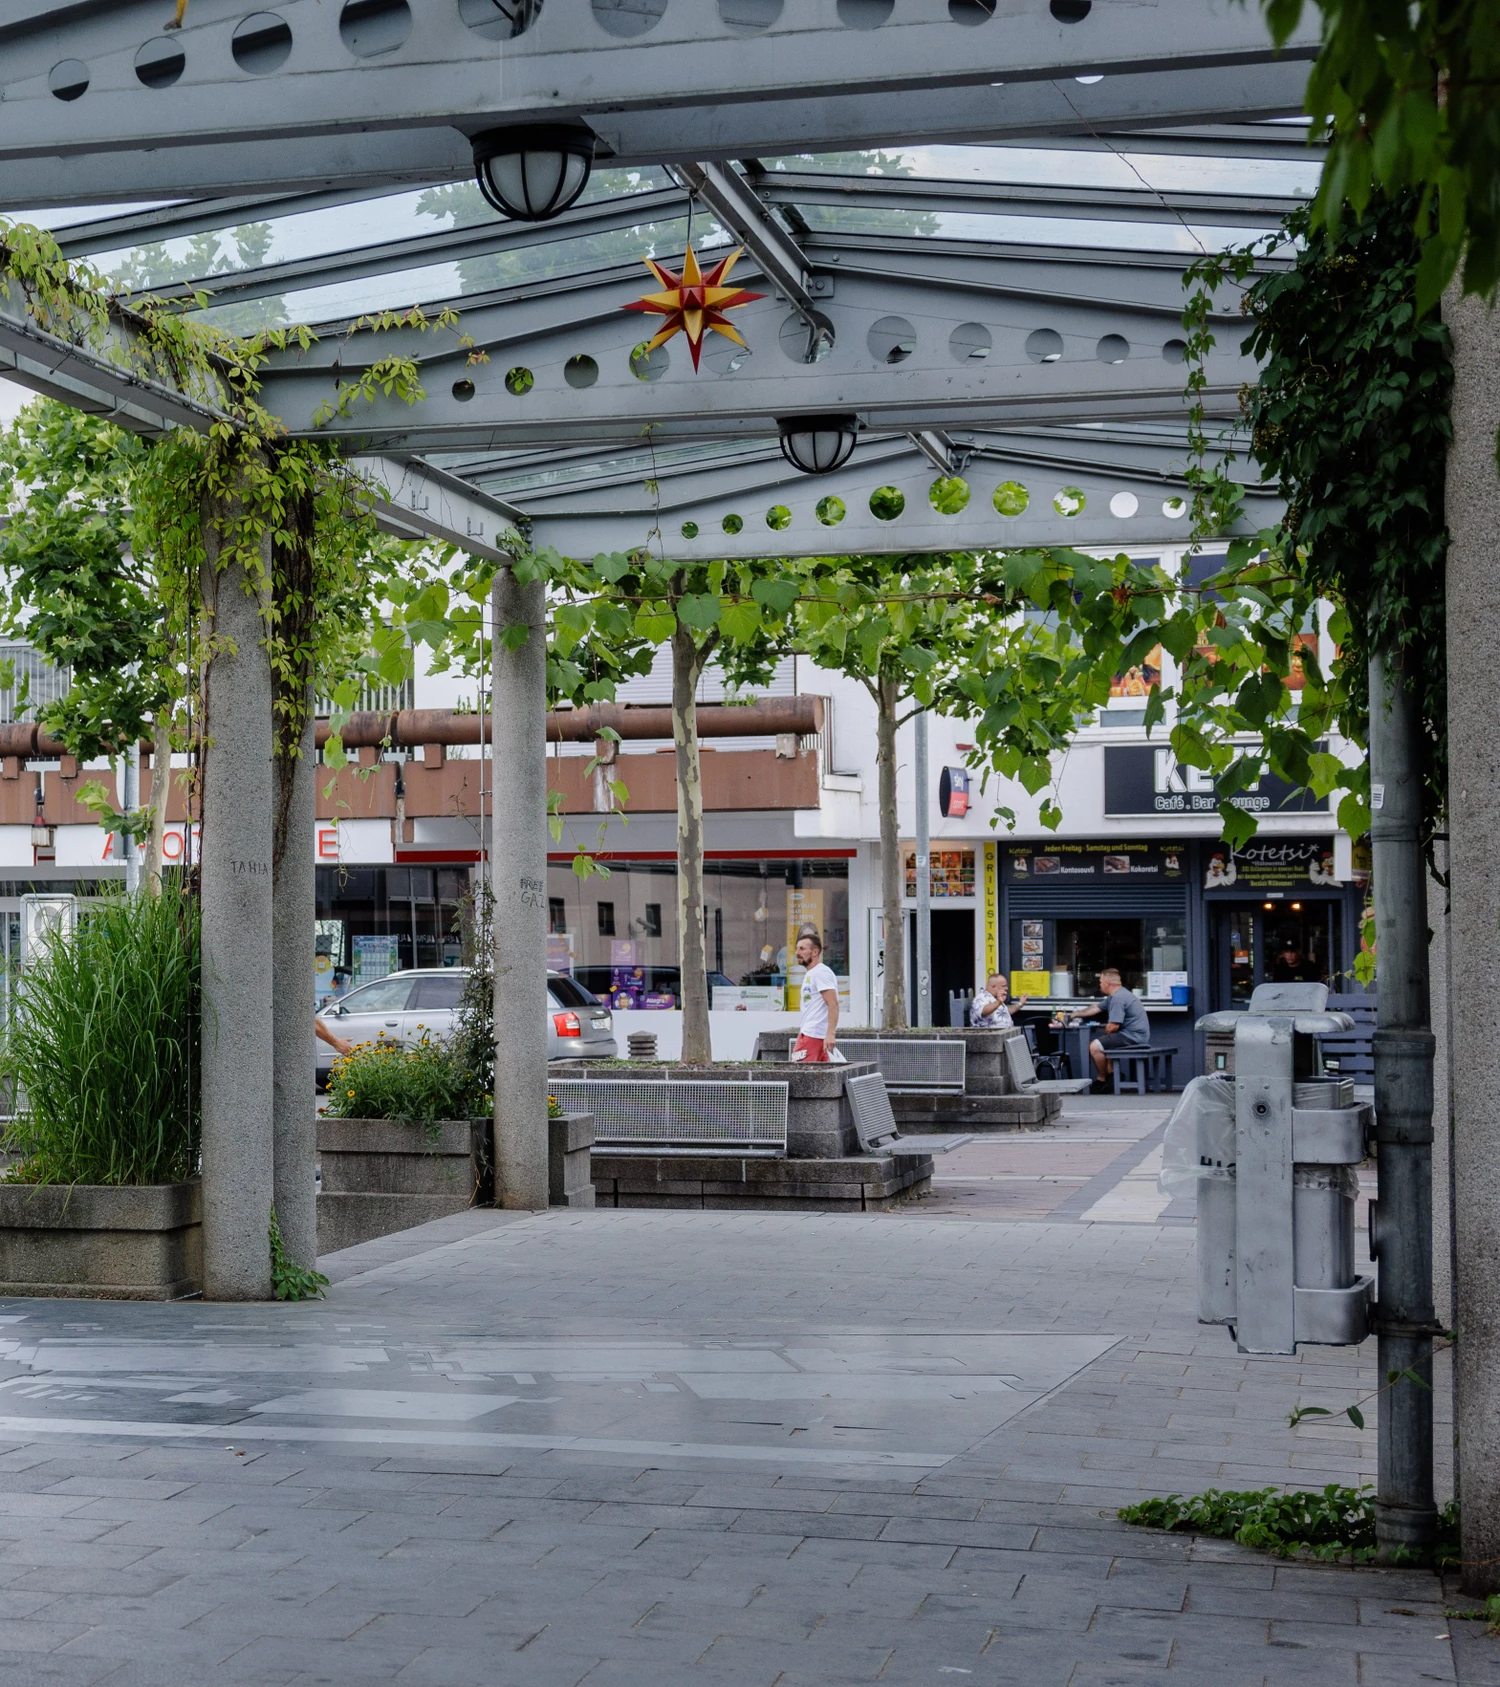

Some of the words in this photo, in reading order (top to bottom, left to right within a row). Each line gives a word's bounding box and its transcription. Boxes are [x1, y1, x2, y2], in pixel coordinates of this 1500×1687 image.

[953, 772, 964, 791] sky
[1155, 794, 1185, 810] Café
[1192, 795, 1216, 809] Bar
[1224, 796, 1271, 811] ounge
[1044, 844, 1062, 852] Jeden
[1062, 844, 1082, 853] Freitag
[1086, 844, 1111, 853] Samstag
[1124, 843, 1148, 853] Sonntag
[1130, 865, 1159, 873] Kokoretsi
[985, 852, 995, 976] GRILLSTATIO
